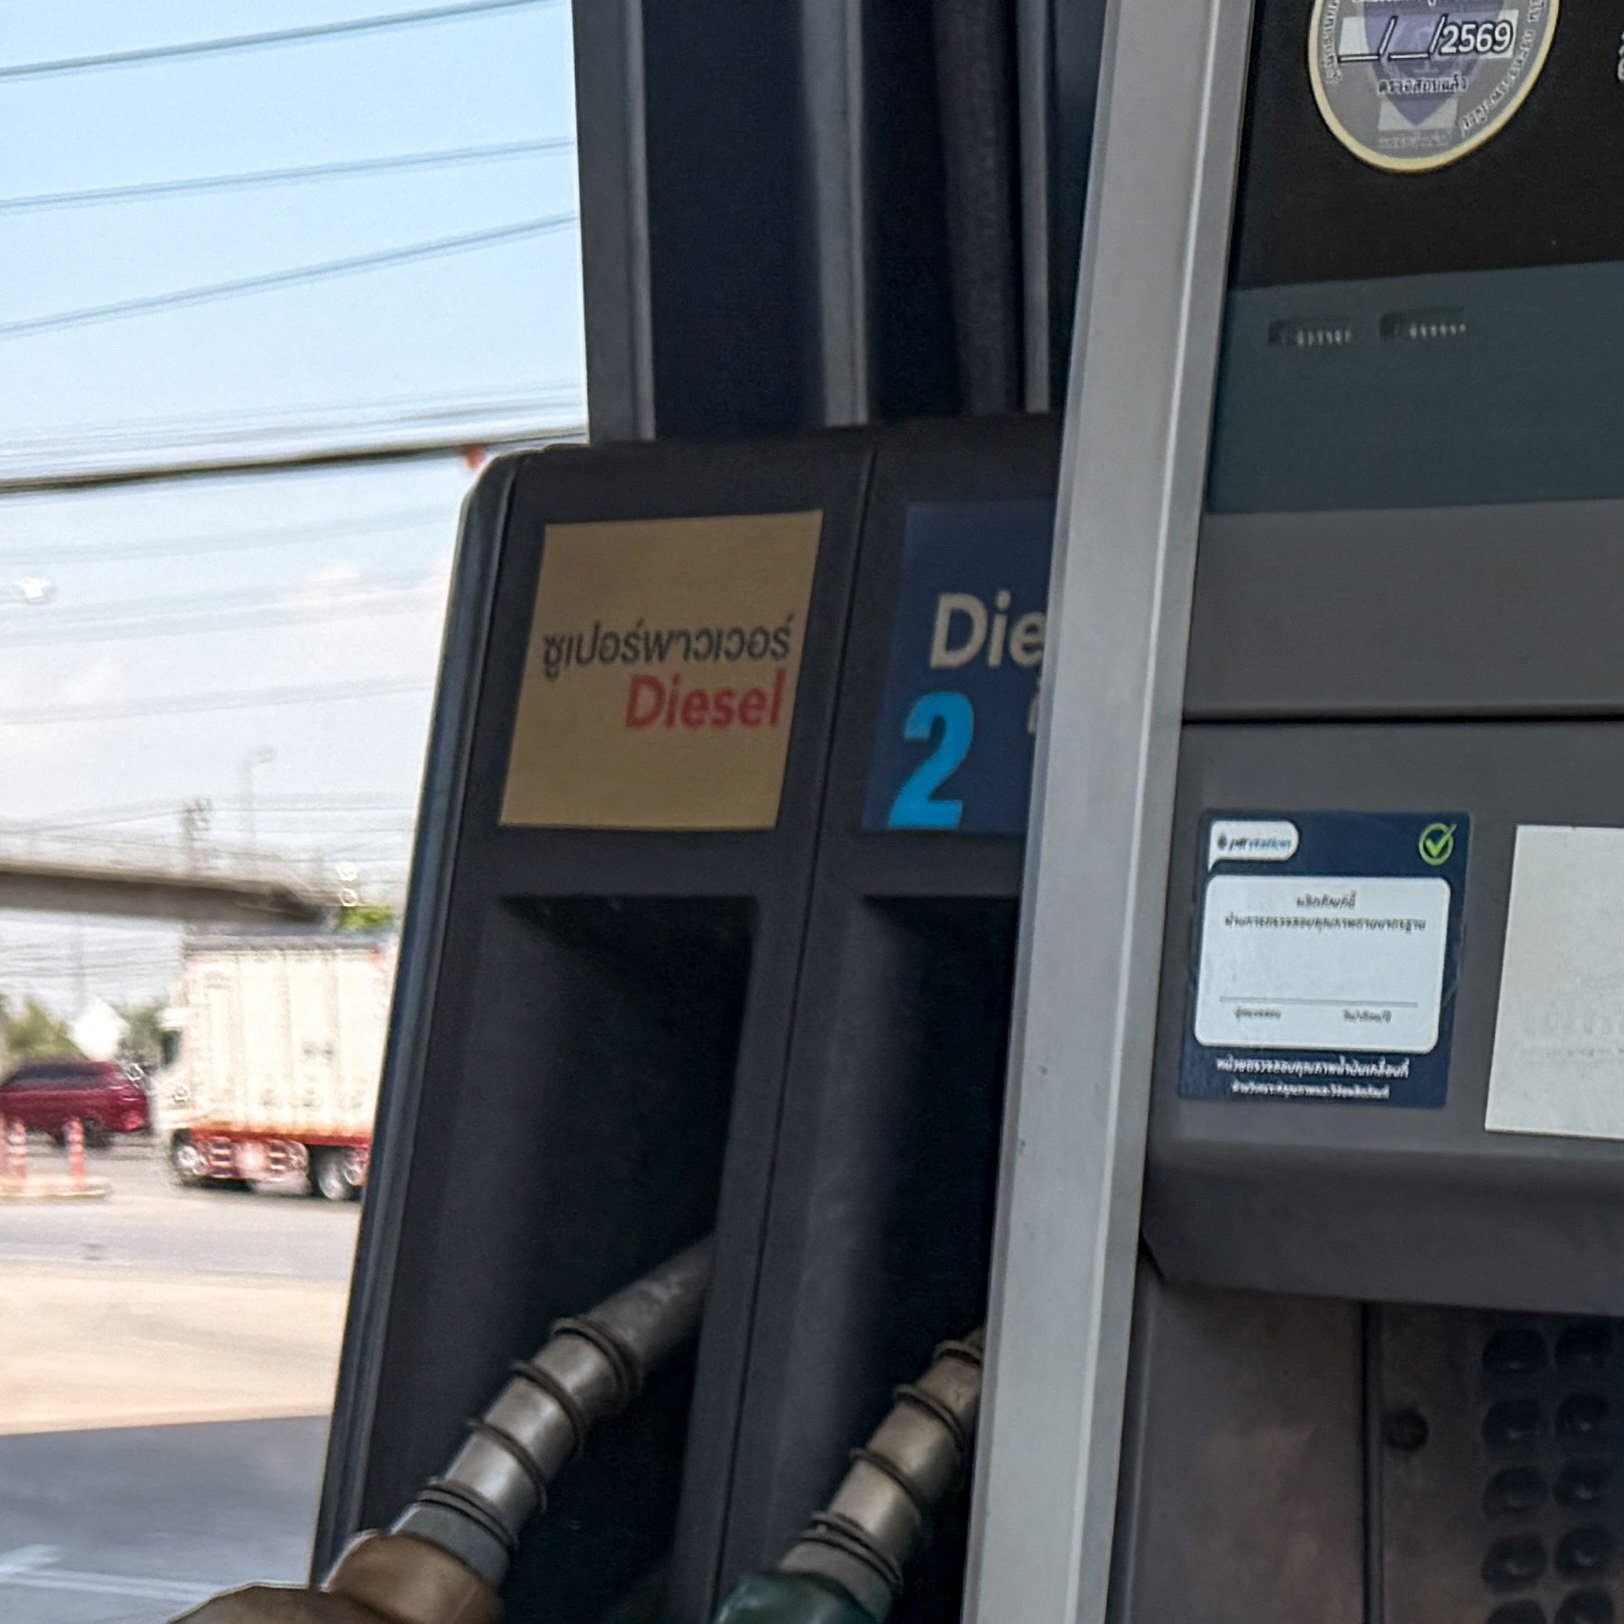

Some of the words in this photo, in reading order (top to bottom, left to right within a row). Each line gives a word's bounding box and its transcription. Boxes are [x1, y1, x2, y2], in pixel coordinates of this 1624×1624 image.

[542, 613, 795, 682] ซูเปอร์พาวเวอร์
[928, 589, 1048, 670] Die
[624, 668, 787, 731] Diesel
[886, 690, 975, 831] 2
